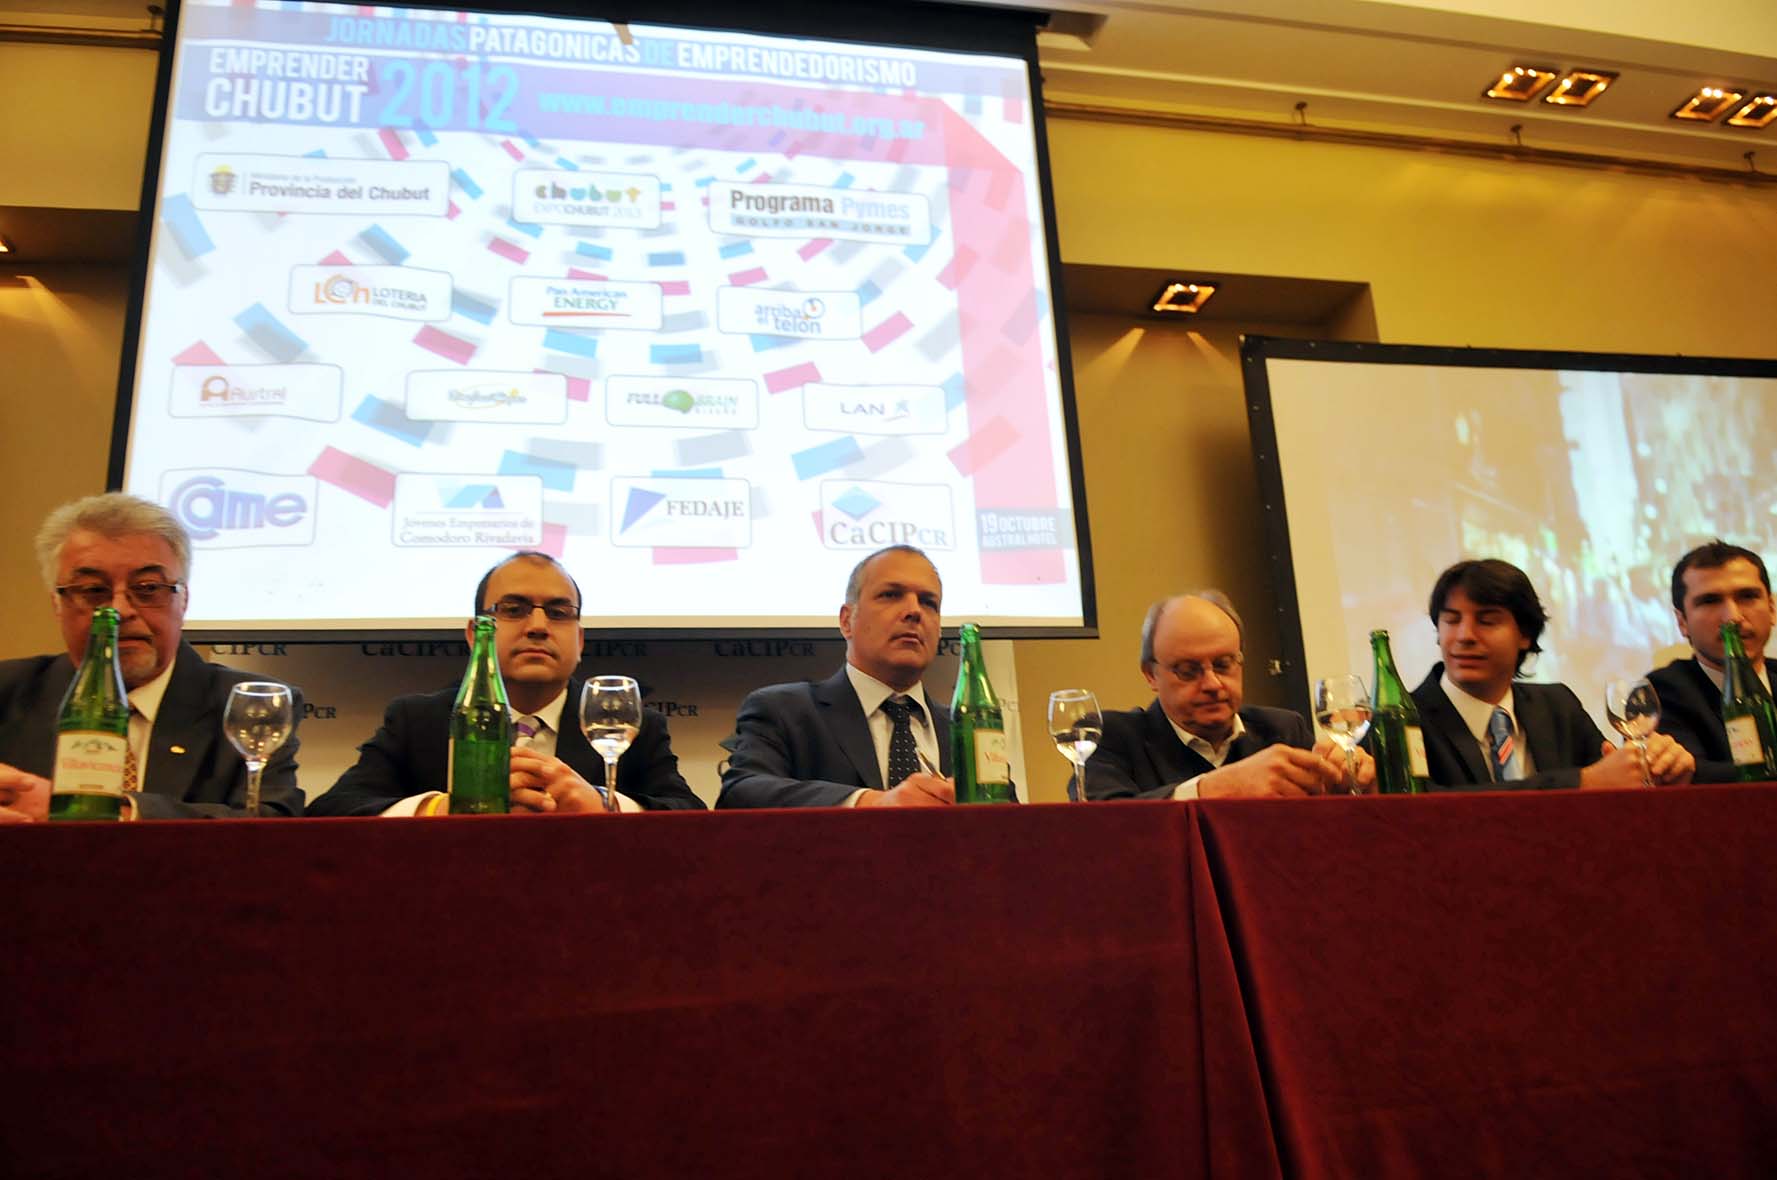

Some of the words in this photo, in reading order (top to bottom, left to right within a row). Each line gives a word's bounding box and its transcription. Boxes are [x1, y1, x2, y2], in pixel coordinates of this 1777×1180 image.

[328, 16, 465, 50] JORNADAS
[469, 28, 641, 64] PATAGONICAS
[645, 41, 673, 66] DE
[677, 47, 917, 87] EMPRENDEDORISMO
[209, 48, 369, 82] EMPRENDER
[205, 78, 369, 124] CHUBUT
[377, 59, 521, 132] 2012
[249, 180, 332, 200] Provincia
[336, 185, 363, 201] del
[368, 185, 431, 201] Chubut
[730, 189, 835, 214] Programa
[841, 197, 911, 219] Pymes
[553, 297, 618, 310] ENERGY
[840, 402, 885, 416] LAN
[667, 500, 744, 519] FEDAJE
[981, 513, 998, 533] 19
